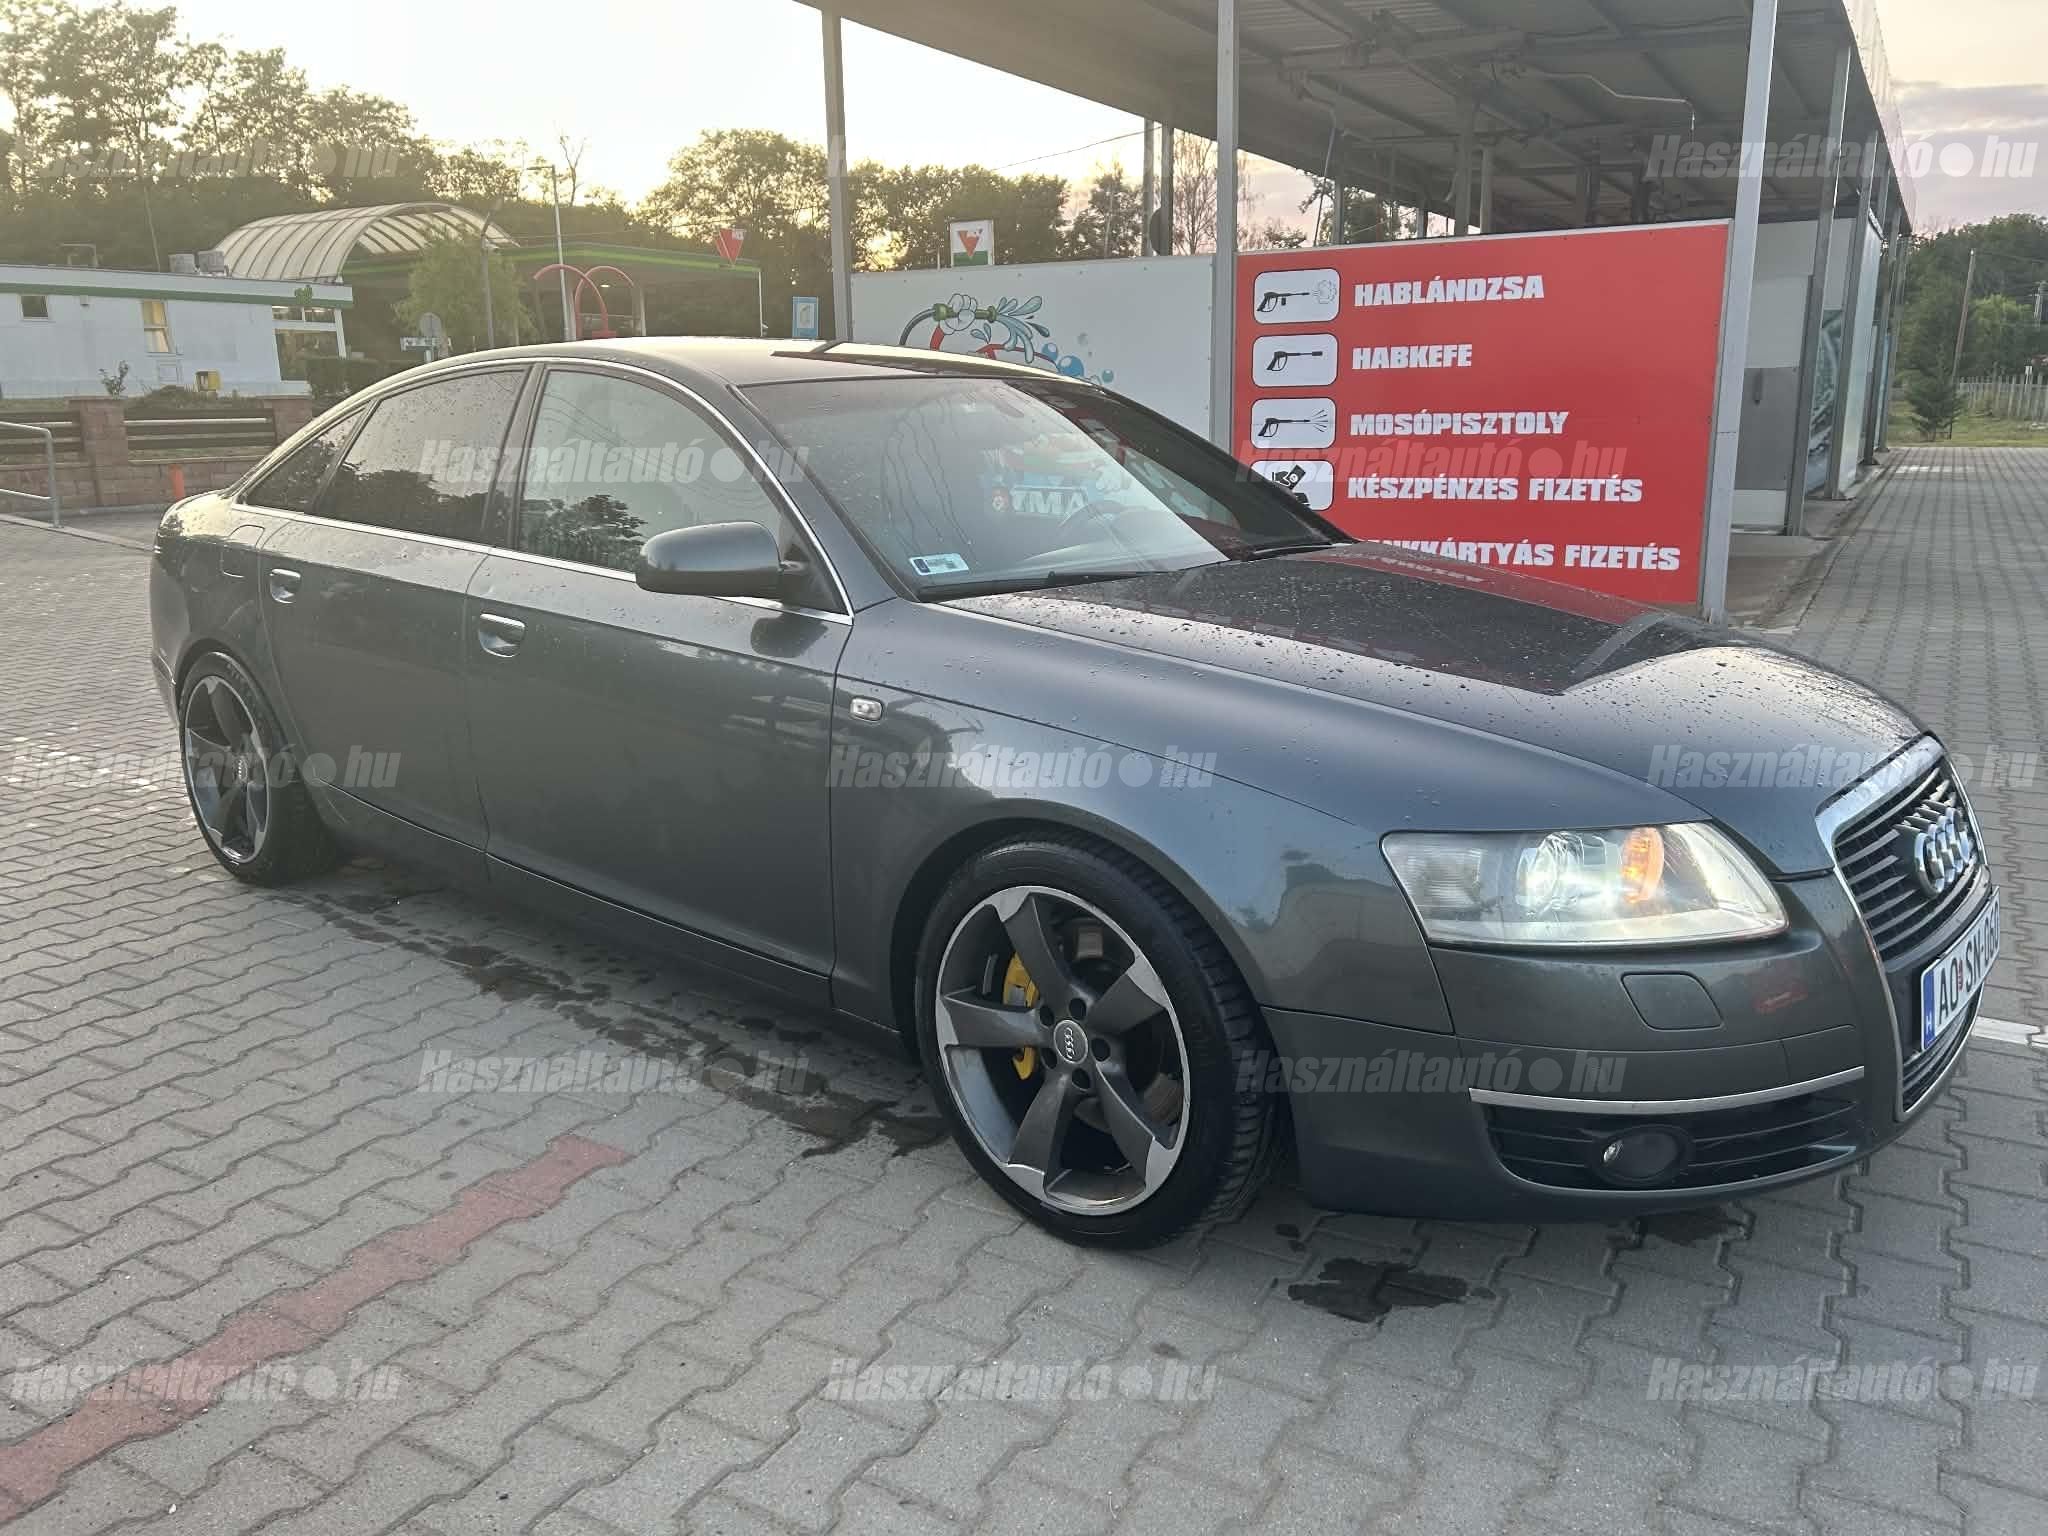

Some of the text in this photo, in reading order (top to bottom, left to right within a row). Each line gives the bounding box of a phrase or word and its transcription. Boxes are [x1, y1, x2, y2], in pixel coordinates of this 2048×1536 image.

[1354, 274, 1544, 307] HABLÁNDZSA
[1352, 344, 1472, 370] HABKEFE
[1350, 408, 1569, 436] MOSÓPISZTOLY
[1347, 474, 1643, 502] KÉSZPÉNZES FIZETÉS
[1368, 537, 1681, 571] KÁRTYÁS FIZETÉS
